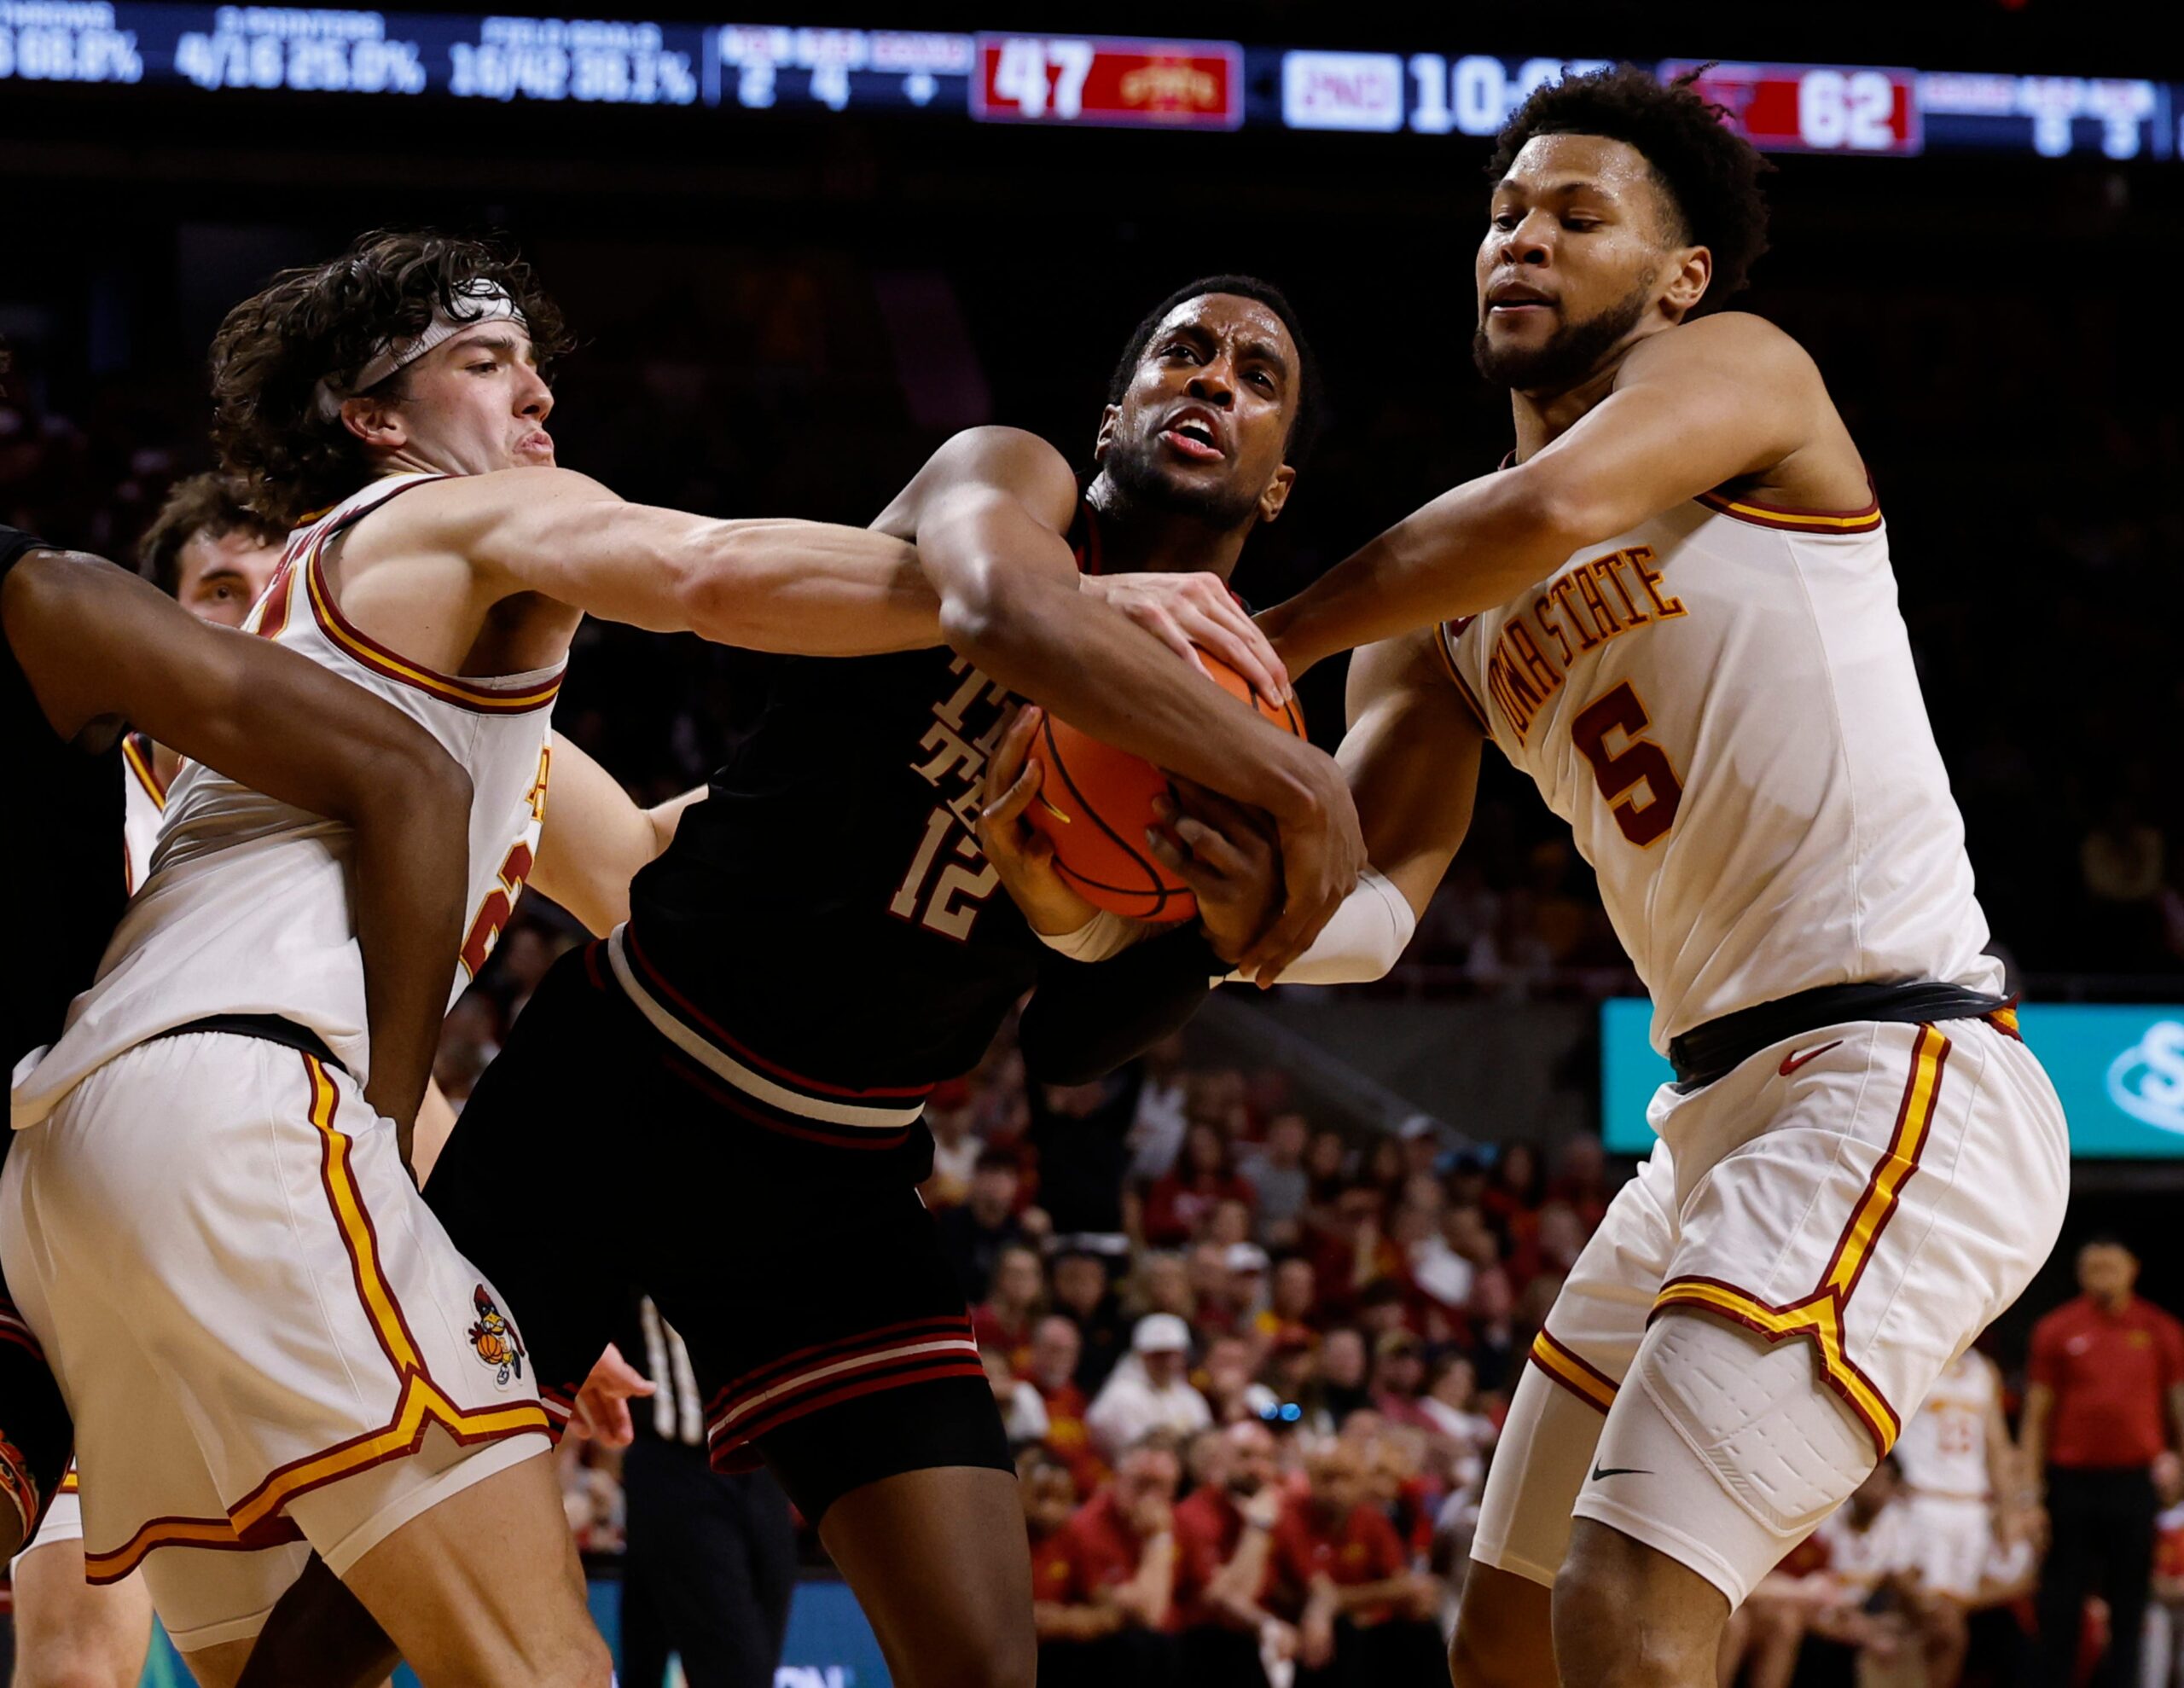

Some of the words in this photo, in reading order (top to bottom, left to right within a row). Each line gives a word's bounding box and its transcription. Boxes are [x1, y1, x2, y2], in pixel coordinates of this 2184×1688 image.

[175, 34, 283, 89] 4/16
[288, 39, 426, 93] 25.0%
[995, 38, 1095, 120] 47
[1798, 69, 1896, 150] 62
[1536, 544, 1690, 668] STATE
[1571, 678, 1683, 850] 5
[888, 805, 1002, 943] 12
